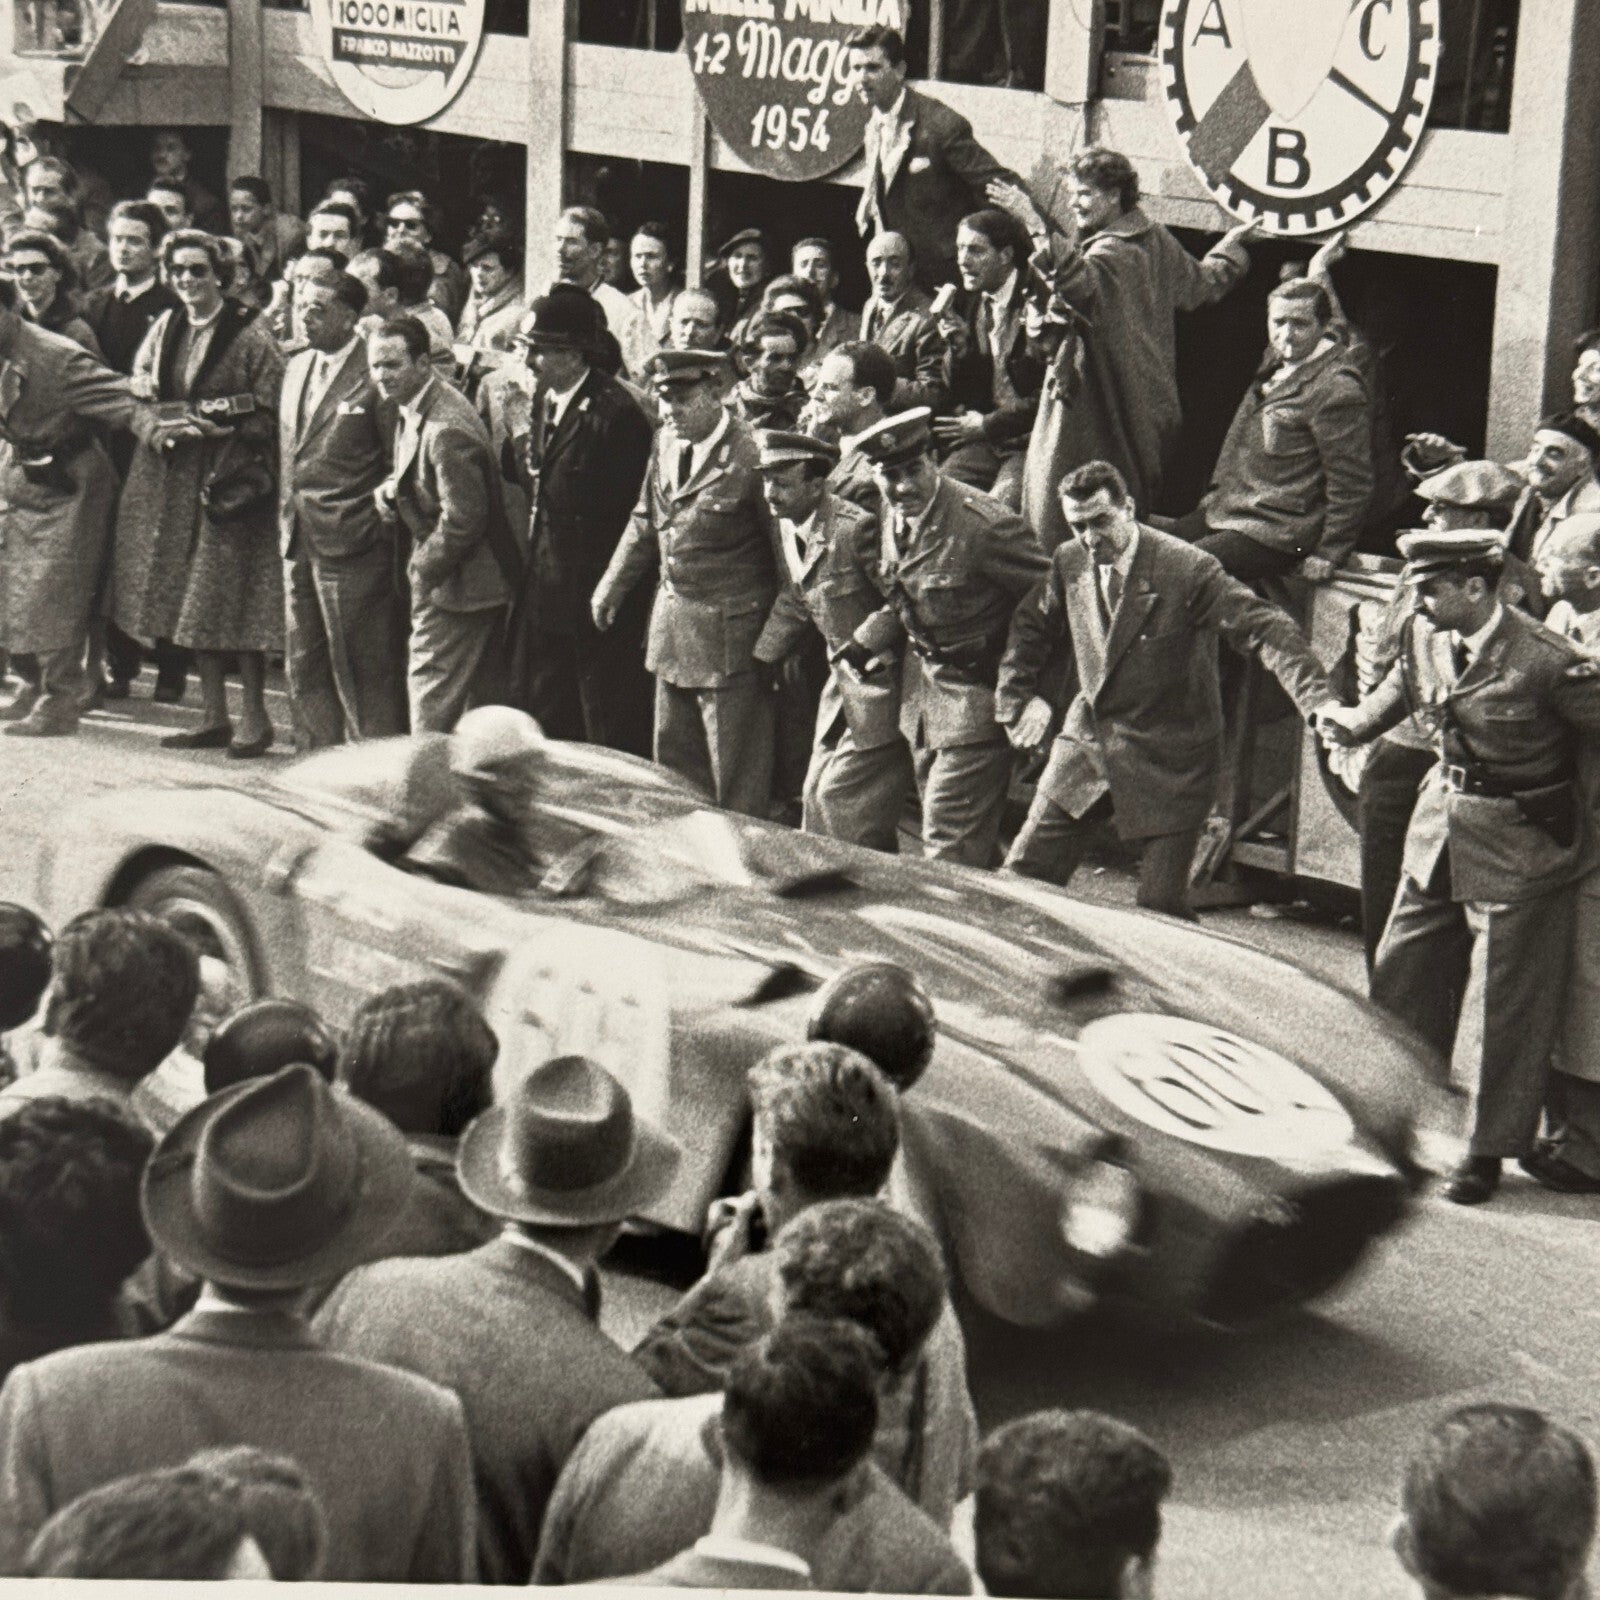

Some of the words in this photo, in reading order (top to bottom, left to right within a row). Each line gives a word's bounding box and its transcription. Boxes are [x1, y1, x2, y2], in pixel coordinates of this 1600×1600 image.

[1191, 0, 1233, 49] A
[1359, 0, 1393, 61] C
[736, 20, 854, 106] Magg
[750, 104, 831, 152] 1954
[1266, 126, 1311, 189] B
